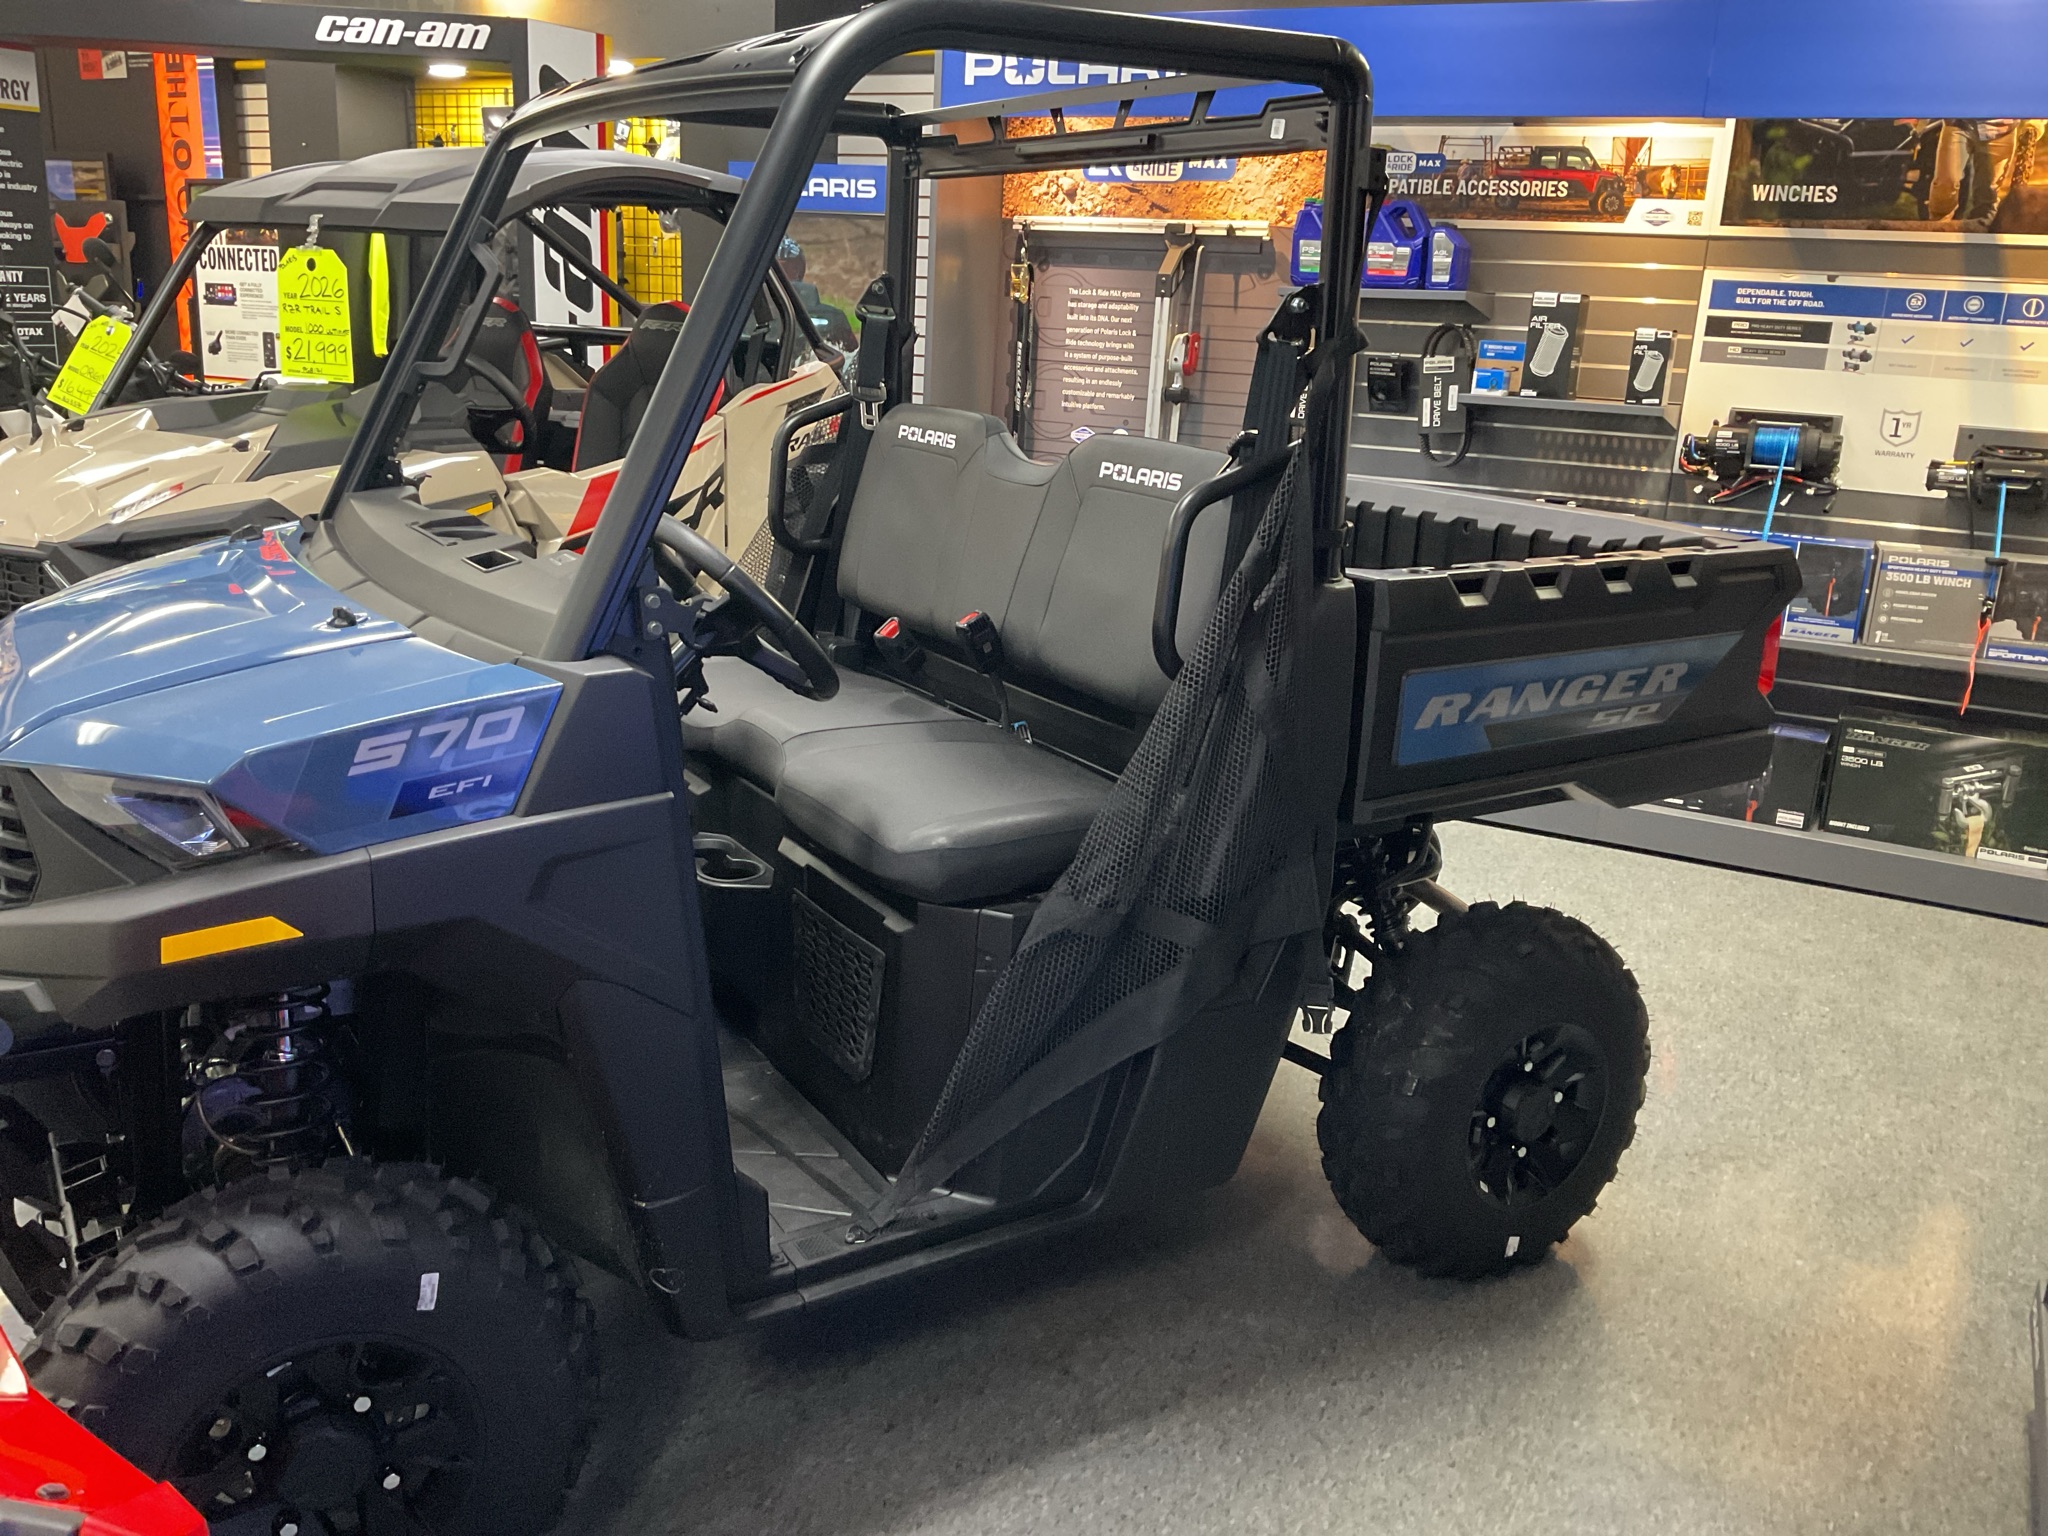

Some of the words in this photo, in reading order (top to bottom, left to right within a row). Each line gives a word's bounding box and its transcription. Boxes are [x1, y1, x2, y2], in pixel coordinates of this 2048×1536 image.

[315, 15, 491, 50] can-am
[0, 78, 30, 101] RGY
[0, 159, 23, 168] lectric
[1388, 154, 1414, 164] LOCK
[1418, 159, 1442, 168] MAX
[801, 177, 877, 199] ARIS
[1387, 179, 1453, 196] PATIBLE
[1456, 180, 1569, 198] ACCESSORIES
[1752, 184, 1838, 204] WINCHES
[0, 220, 22, 230] lways
[200, 246, 278, 272] CONNECTED
[0, 270, 23, 283] ANTY
[297, 273, 344, 299] 2026
[13, 293, 47, 303] YEARS
[1737, 288, 1786, 297] DEPENDABLE.
[1788, 290, 1814, 298] TOUGH.
[1735, 296, 1756, 304] BUILT
[282, 303, 301, 313] RZR
[303, 305, 330, 315] TRAIL
[334, 306, 342, 315] S
[1109, 304, 1139, 312] adaptability
[17, 327, 44, 336] OTAX
[284, 325, 304, 334] MODEL
[1078, 340, 1105, 348] technology
[1106, 341, 1122, 349] brings
[1063, 377, 1084, 385] resulting
[1099, 379, 1122, 388] endlessly
[1434, 375, 1442, 394] BELT
[1106, 393, 1135, 401] remarkably
[1433, 395, 1441, 427] DRIVE
[1889, 417, 1901, 438] 1
[898, 424, 957, 449] POLARIS
[1874, 449, 1915, 459] WARRANTY
[1099, 461, 1184, 491] POLARIS
[1888, 555, 1950, 568] POLARIS
[1886, 571, 1914, 583] 3500
[1915, 574, 1931, 584] LB
[1933, 576, 1972, 588] WINCH
[1414, 662, 1689, 730] RANGER
[1586, 703, 1661, 729] SP
[348, 705, 526, 777] 570
[428, 774, 493, 800] EFI
[1980, 847, 2025, 860] POLARIS
